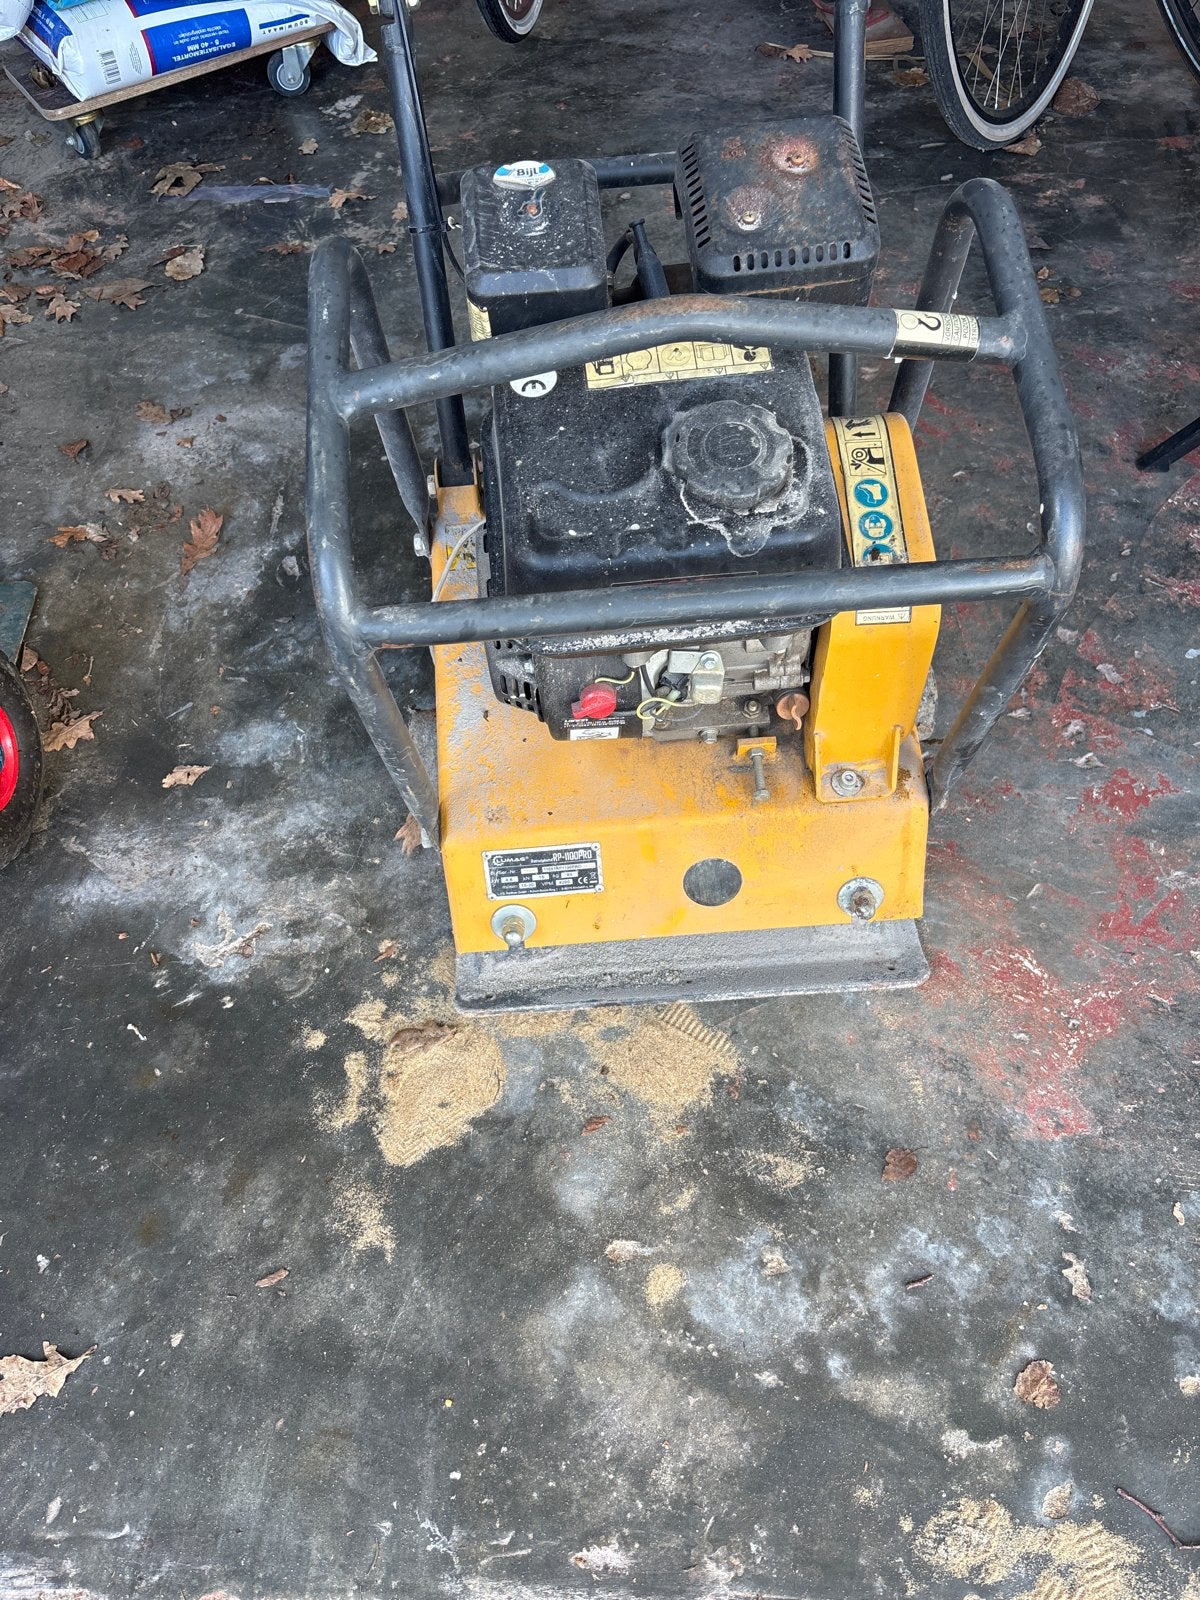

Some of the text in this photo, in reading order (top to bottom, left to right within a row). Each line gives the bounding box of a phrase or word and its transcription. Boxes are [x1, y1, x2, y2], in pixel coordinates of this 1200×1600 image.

[186, 43, 200, 52] MM
[200, 41, 209, 49] 40
[172, 41, 236, 62] EGALISATIEMORTEL
